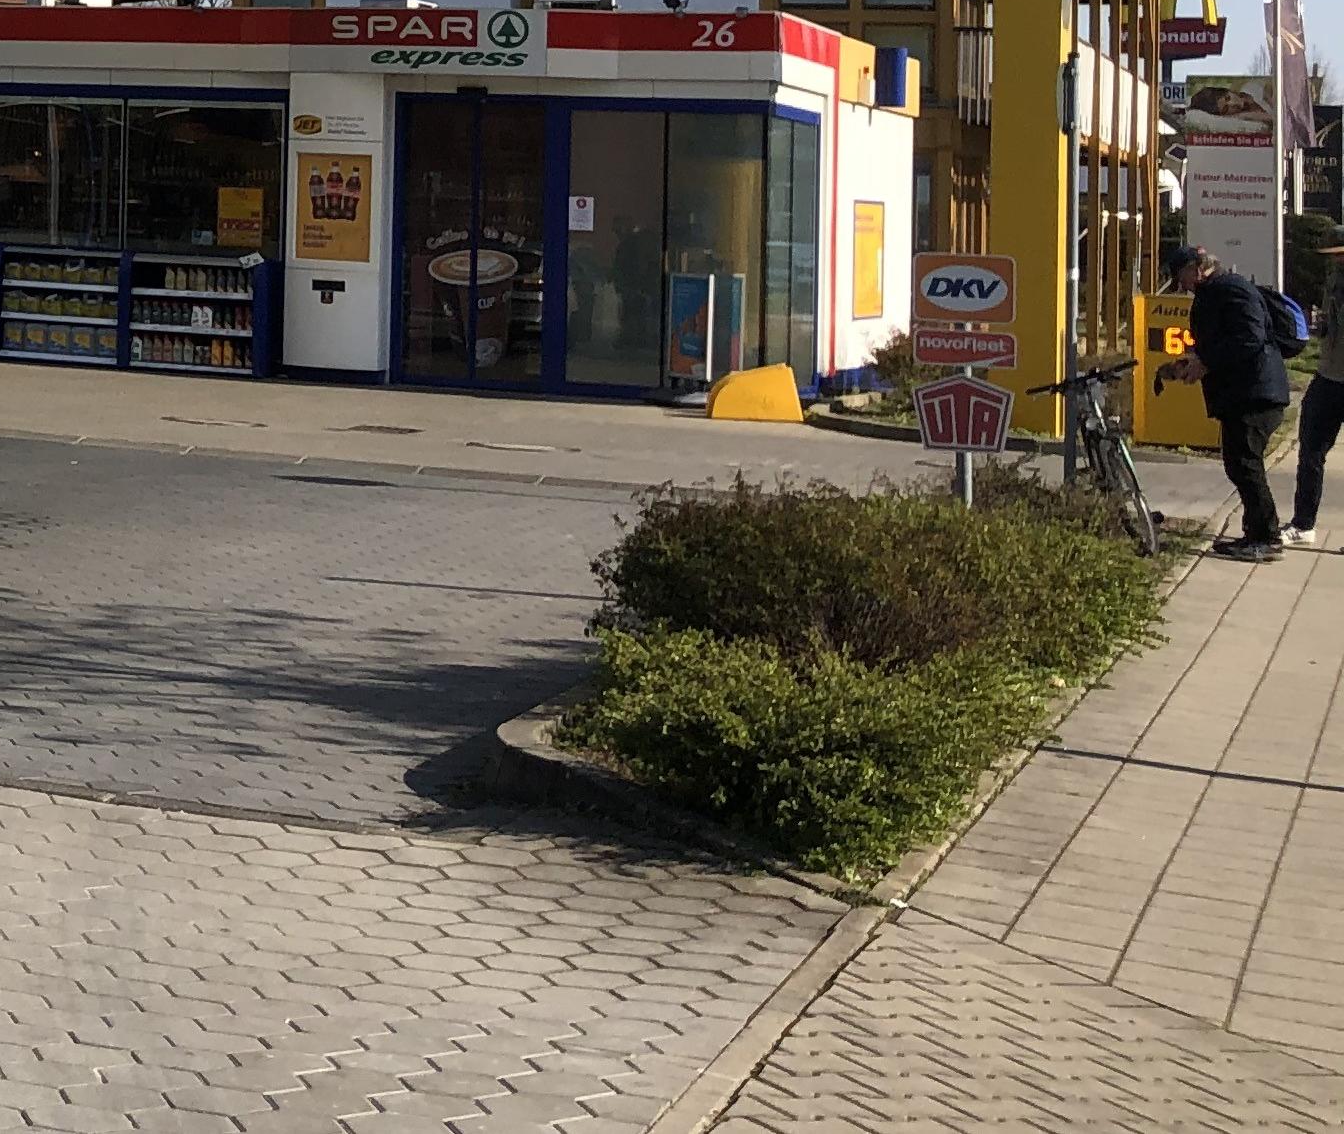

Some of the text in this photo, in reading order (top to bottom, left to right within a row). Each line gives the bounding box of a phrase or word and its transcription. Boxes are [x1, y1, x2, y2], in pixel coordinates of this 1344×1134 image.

[331, 15, 474, 42] SPAR
[691, 20, 737, 48] 26
[370, 49, 529, 70] express
[926, 276, 1001, 300] DKV
[919, 337, 1008, 354] novofleet
[920, 382, 1004, 446] UTA
